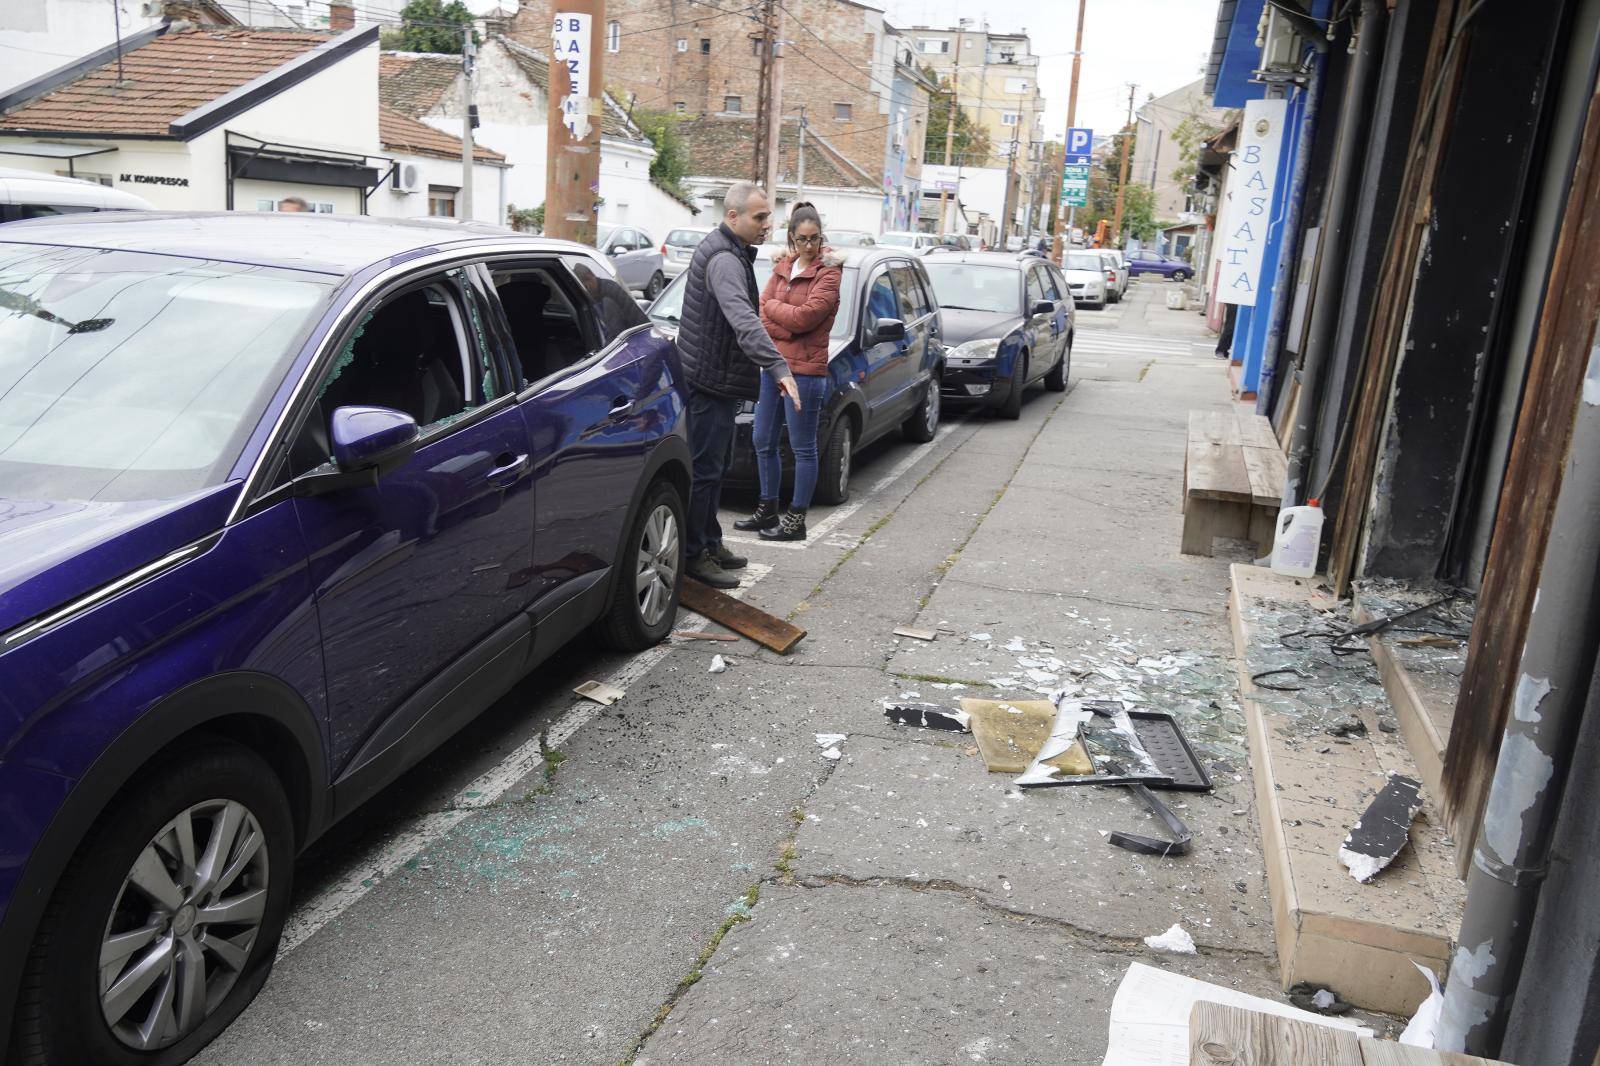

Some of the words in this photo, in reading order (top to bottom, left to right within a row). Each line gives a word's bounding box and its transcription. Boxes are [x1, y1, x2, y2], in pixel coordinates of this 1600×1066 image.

[567, 18, 580, 133] BAZENI
[1071, 130, 1087, 152] P
[120, 173, 132, 182] AK
[134, 174, 189, 187] KOMPRESOR
